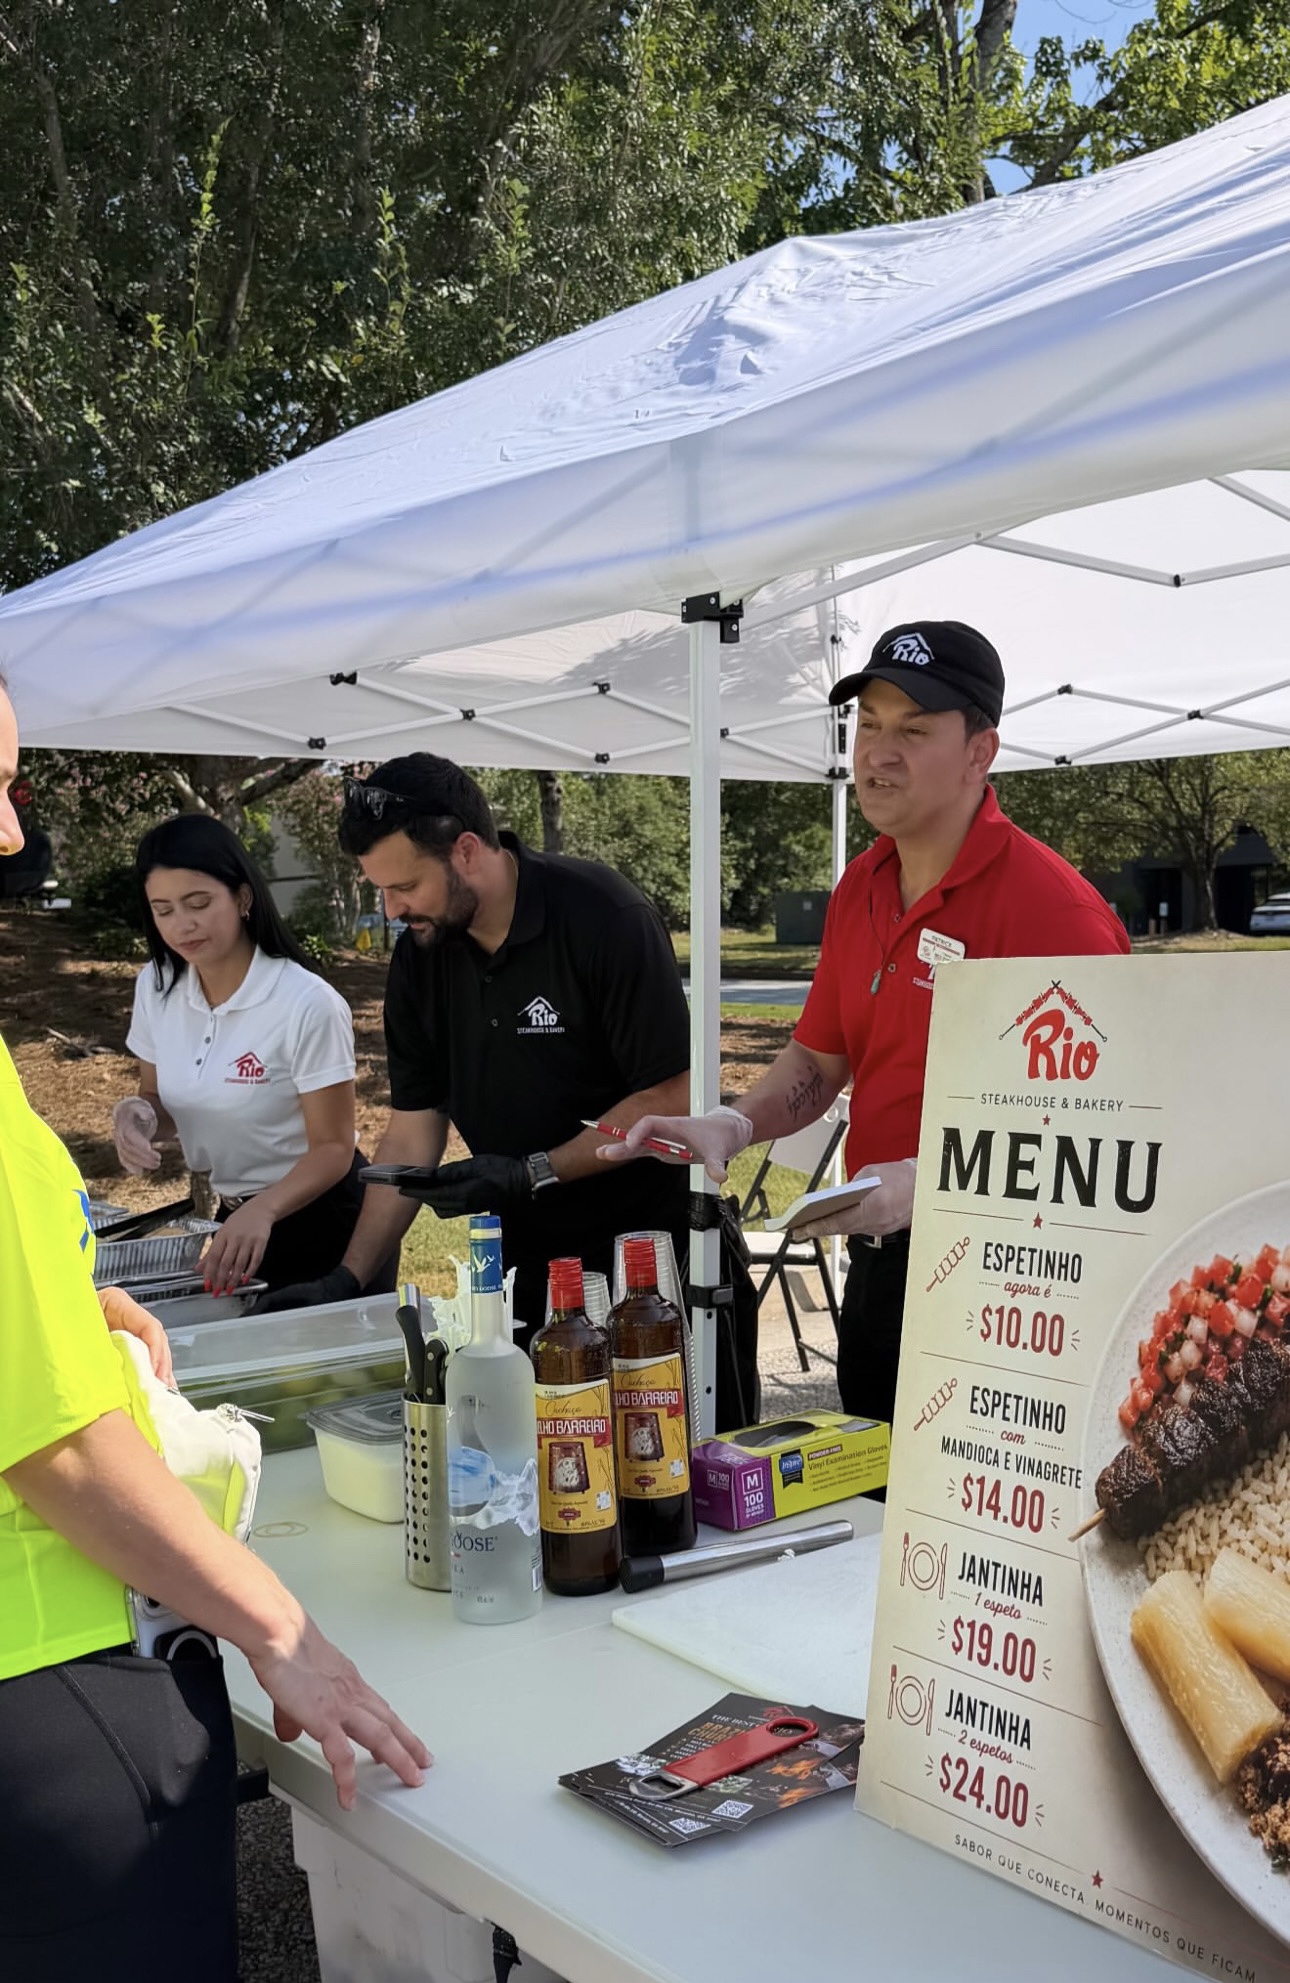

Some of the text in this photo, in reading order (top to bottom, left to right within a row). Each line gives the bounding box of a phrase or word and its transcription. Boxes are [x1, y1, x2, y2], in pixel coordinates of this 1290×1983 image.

[892, 638, 930, 665] Rio
[528, 1003, 558, 1026] Rio
[1022, 1008, 1100, 1081] Rio
[237, 1058, 265, 1077] Rio
[980, 1093, 1124, 1112] STEAKHOUSE & BAKERY
[937, 1126, 1163, 1214] MENU
[982, 1241, 1083, 1284] ESPETINHO
[1004, 1281, 1052, 1298] agora é
[980, 1303, 1065, 1357] $10.00
[556, 1419, 606, 1435] BARREIRO
[969, 1385, 1066, 1435] ESPETINHO
[1000, 1429, 1027, 1445] com
[746, 1473, 759, 1489] M
[941, 1435, 1083, 1490] MANDIOCA E VINAGRETE
[744, 1491, 764, 1507] 100
[961, 1472, 1045, 1533] $14.00
[957, 1552, 1044, 1607] JANTINHA
[974, 1592, 1022, 1620] 1 espeto
[951, 1616, 1037, 1683] $19.00
[945, 1688, 1032, 1751] JANTINHA
[958, 1729, 1014, 1764] 2 espetos
[939, 1752, 1029, 1828] $24.00
[955, 1834, 993, 1861] SABOR
[998, 1855, 1022, 1875] QUE
[1095, 1899, 1170, 1943] MOMENTOS
[1176, 1937, 1205, 1960] QUE
[1211, 1953, 1256, 1983] FICAM
